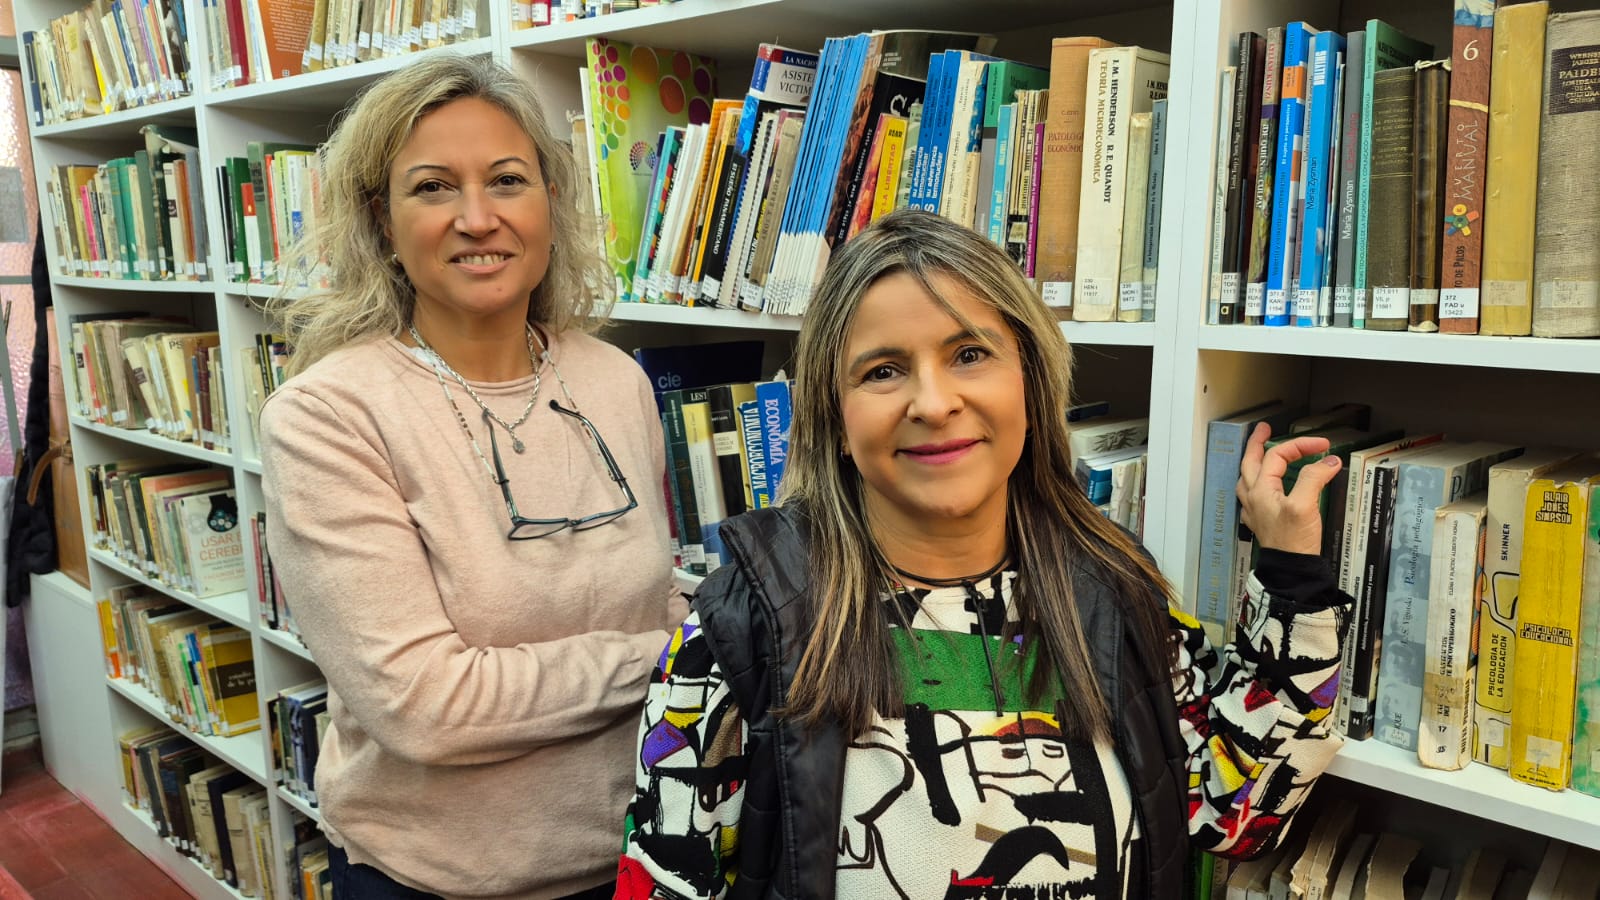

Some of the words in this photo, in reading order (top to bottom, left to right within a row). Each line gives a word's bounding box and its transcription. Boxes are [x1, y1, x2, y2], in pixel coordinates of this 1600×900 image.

[1313, 50, 1327, 85] BULLYING
[1463, 40, 1479, 61] 6
[1098, 60, 1108, 96] TEORÍA
[1112, 66, 1119, 77] M.
[1108, 79, 1119, 137] HENDERSON
[1236, 92, 1244, 121] aprendizaje
[1048, 132, 1083, 141] PATOLOG
[1092, 99, 1106, 184] MICROECONÓMICA
[886, 144, 896, 191] LIBERTAD
[928, 146, 938, 188] advertencia
[932, 152, 944, 199] termonuclear
[1308, 157, 1317, 187] Zysman
[1462, 120, 1479, 201] MANUAL
[726, 170, 737, 197] SUEÑO
[1104, 164, 1113, 204] QUANDT
[1307, 187, 1315, 210] María
[1344, 180, 1355, 214] Zysman
[713, 202, 729, 255] PANAMERICANO
[1342, 214, 1352, 240] María
[1454, 245, 1465, 268] PALOS
[1456, 268, 1464, 279] DE
[658, 372, 682, 389] cie
[765, 399, 784, 465] ECONOMÍA
[1215, 489, 1227, 533] RORSCHACH
[1542, 502, 1568, 513] JONES
[1544, 492, 1569, 503] BLAIR
[1536, 512, 1572, 524] SIMPSON
[200, 533, 233, 548] USAR
[1344, 523, 1353, 559] APRENDIZAJE
[1404, 544, 1419, 585] Psicología
[1412, 496, 1424, 543] pedagógica
[1501, 523, 1511, 561] SKINNER
[1364, 586, 1372, 620] posmodernidad
[1446, 608, 1457, 668] PSICOPEDAGOGICO
[1492, 633, 1499, 642] DE
[1520, 630, 1573, 647] EDUCACIONAL
[1488, 646, 1498, 696] PSICOLOGIA
[1499, 636, 1508, 687] EDUCACION
[1497, 688, 1503, 698] LA
[1438, 725, 1447, 733] 17
